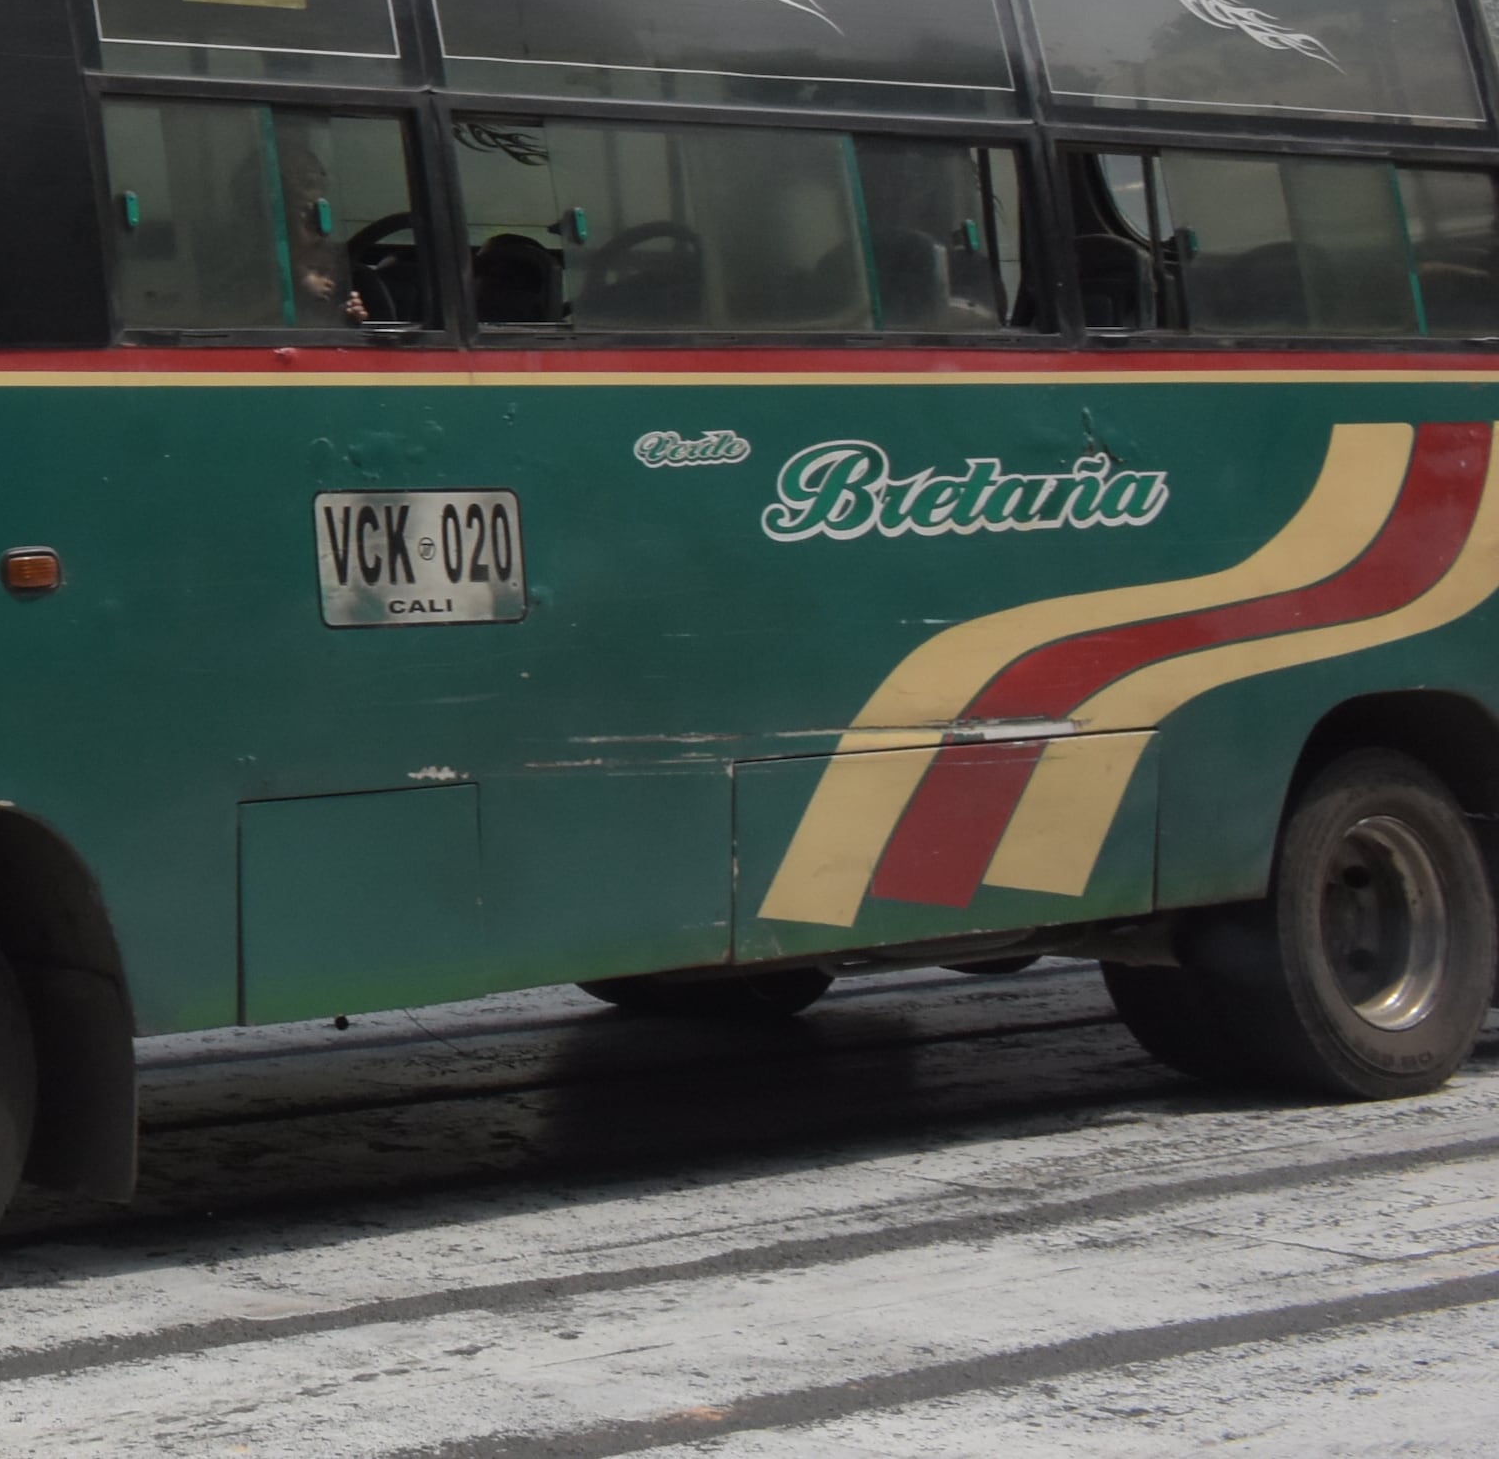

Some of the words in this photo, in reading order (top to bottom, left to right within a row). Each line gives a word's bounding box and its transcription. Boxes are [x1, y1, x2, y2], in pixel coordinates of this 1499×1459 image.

[634, 430, 751, 468] Verde
[761, 439, 1170, 542] Bretaña
[323, 503, 416, 586] VCK
[441, 503, 512, 584] 020
[388, 598, 453, 614] CALI
